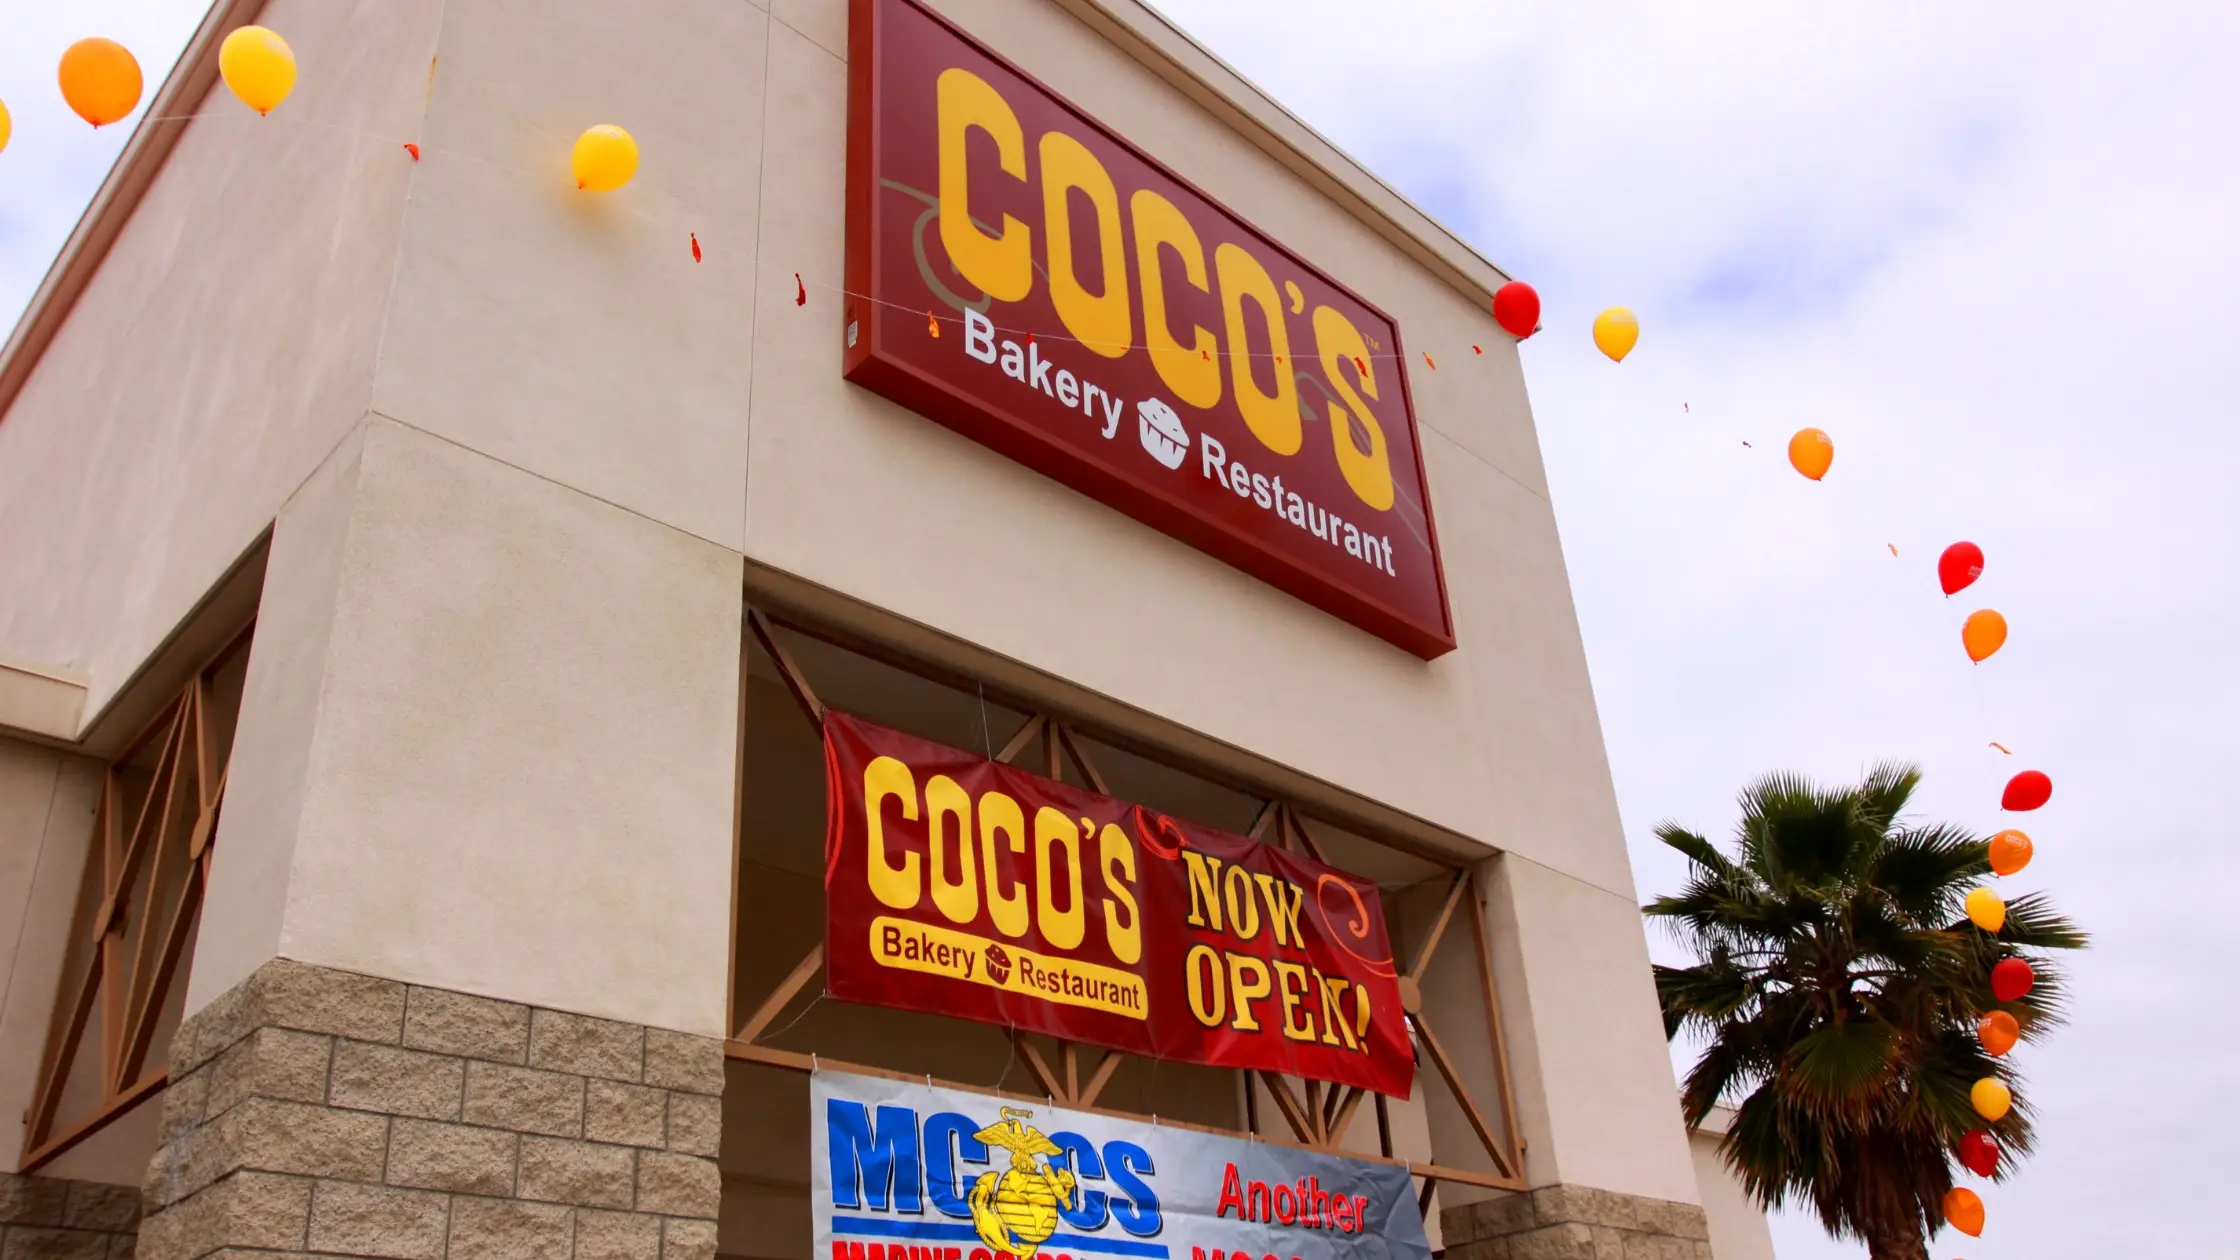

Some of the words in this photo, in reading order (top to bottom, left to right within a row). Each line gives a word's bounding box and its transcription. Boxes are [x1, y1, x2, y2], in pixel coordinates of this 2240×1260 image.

[938, 68, 1394, 511] COCO'S
[963, 305, 1125, 440] Bakery
[1200, 432, 1397, 577] Restaurant
[864, 755, 1142, 965] COCO'S
[1181, 850, 1305, 949] NOW
[882, 925, 976, 979] Bakery
[1019, 956, 1141, 1011] Restaurant
[1186, 945, 1371, 1056] OPEN!
[1216, 1162, 1369, 1234] Another
